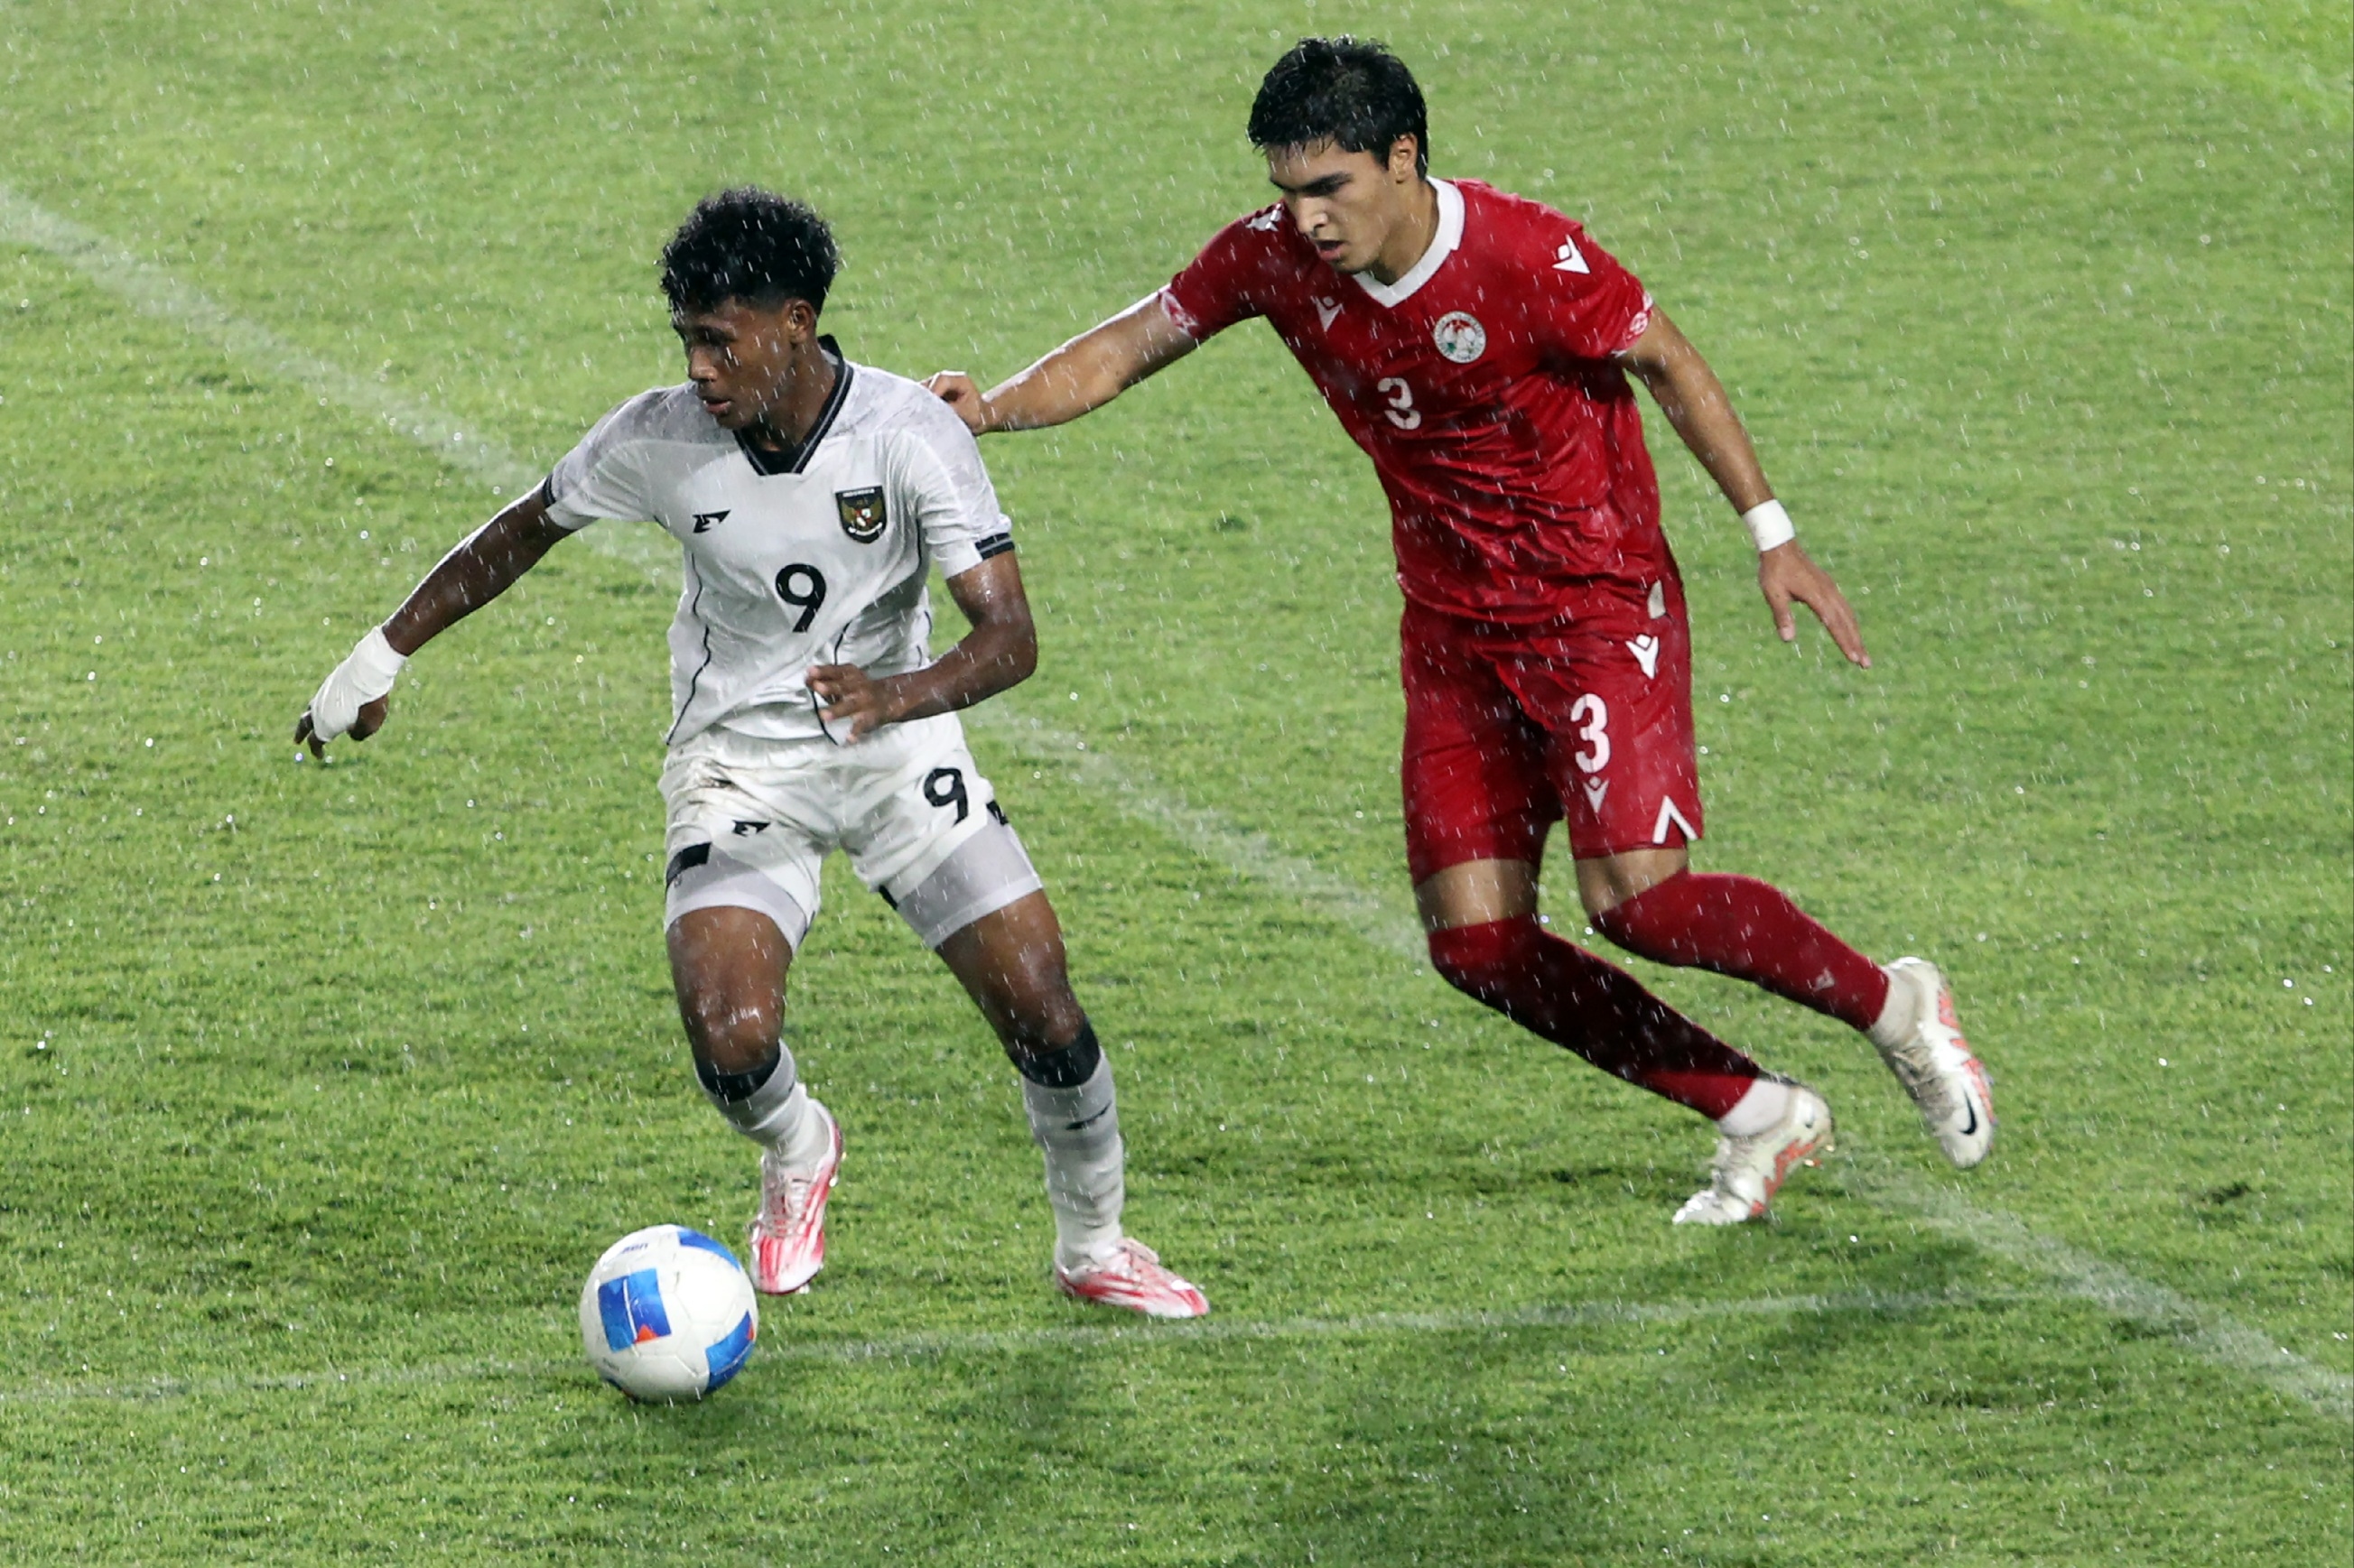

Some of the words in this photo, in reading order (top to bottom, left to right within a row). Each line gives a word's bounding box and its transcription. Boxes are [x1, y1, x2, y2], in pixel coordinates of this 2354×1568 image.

[1377, 377, 1421, 431] 3
[775, 563, 826, 633] 9
[1570, 692, 1611, 774] 3
[923, 767, 968, 826] 9
